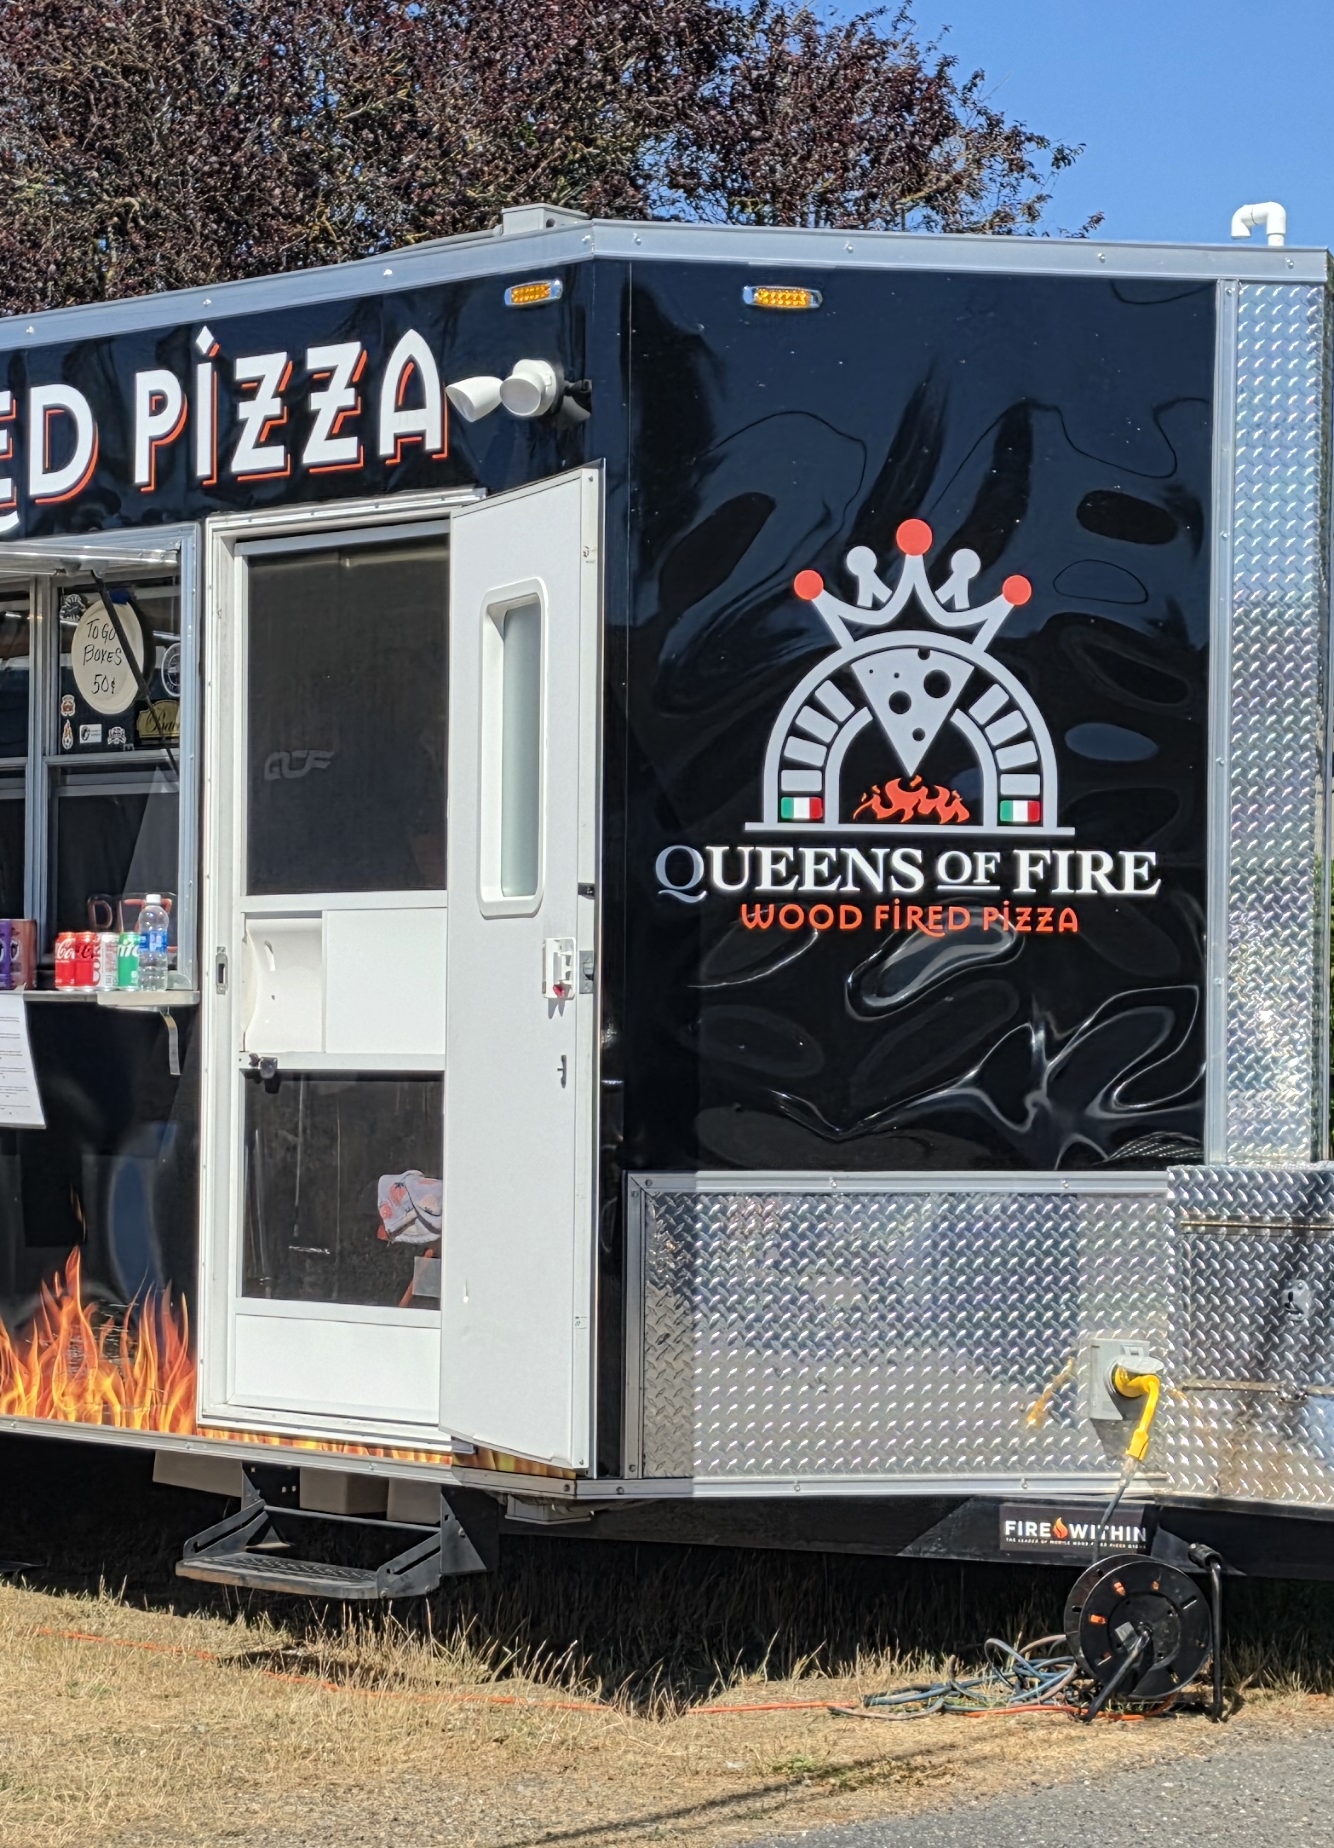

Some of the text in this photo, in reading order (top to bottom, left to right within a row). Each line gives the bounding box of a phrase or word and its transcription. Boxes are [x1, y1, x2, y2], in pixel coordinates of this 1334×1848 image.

[133, 325, 451, 493] PIZZA
[83, 643, 123, 667] BOXES
[655, 845, 1162, 903] QUEENS OF FIRE
[740, 898, 1080, 937] WOOD FIRED PIZZA
[1005, 1520, 1051, 1537] FIRE
